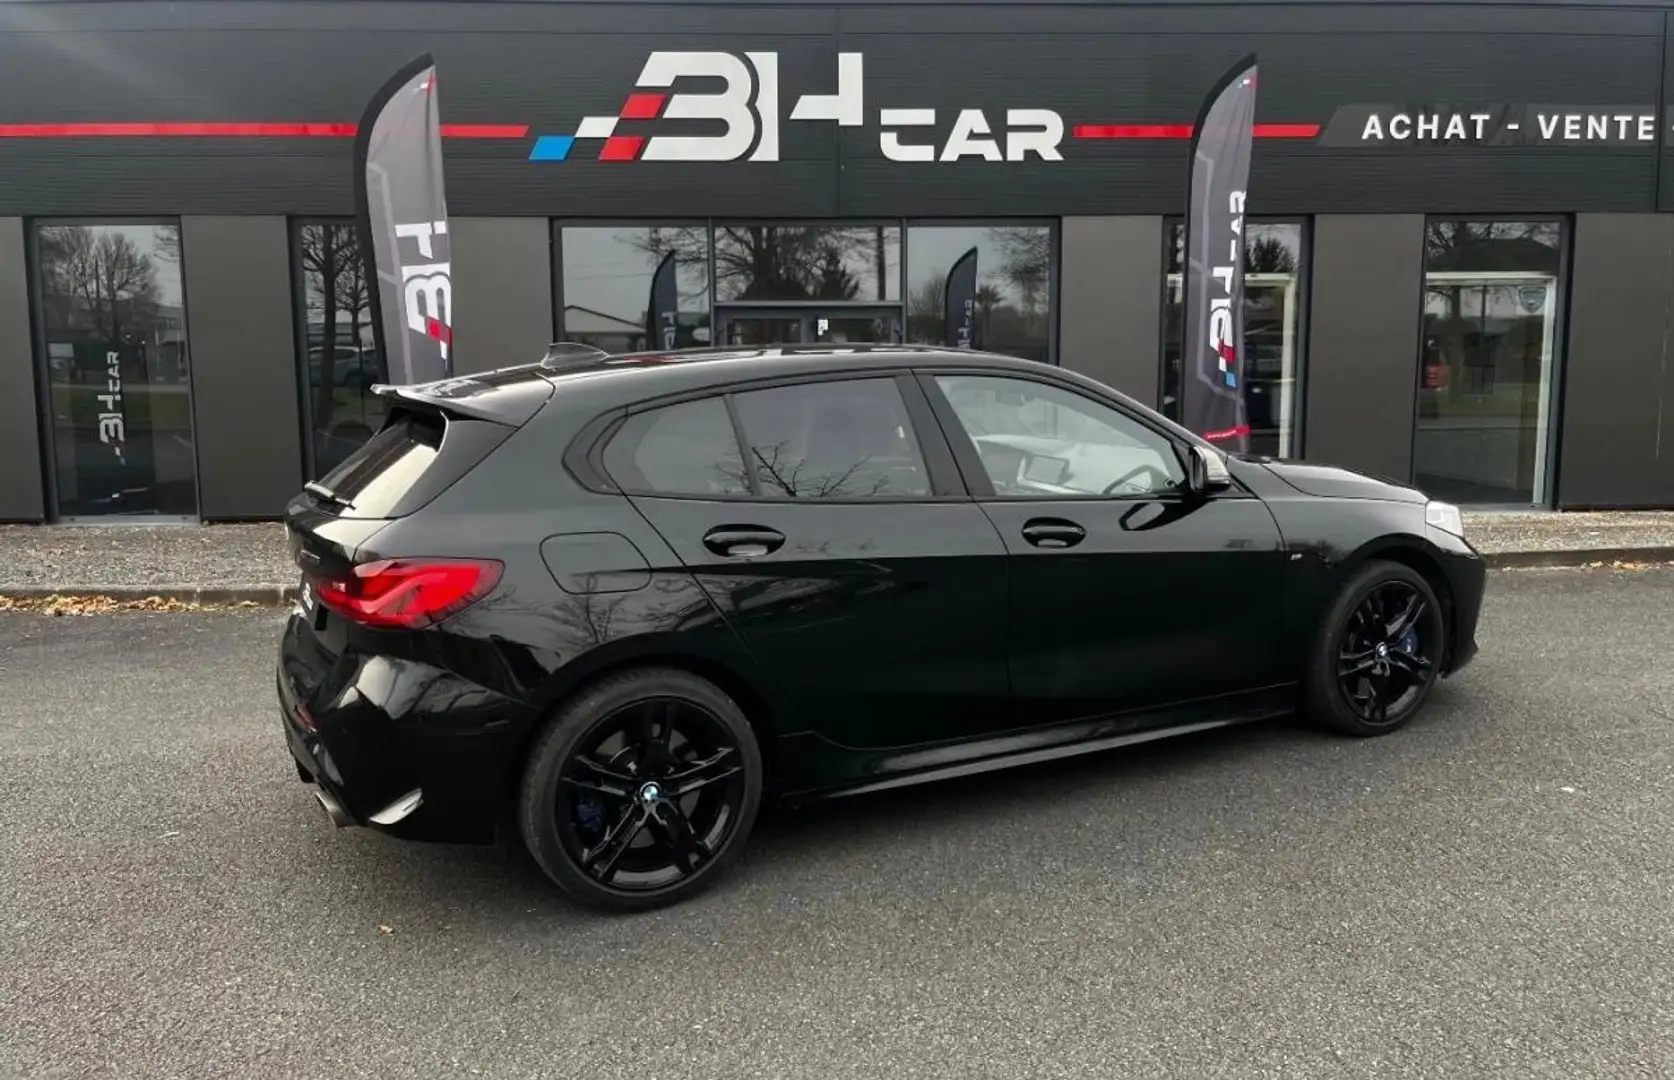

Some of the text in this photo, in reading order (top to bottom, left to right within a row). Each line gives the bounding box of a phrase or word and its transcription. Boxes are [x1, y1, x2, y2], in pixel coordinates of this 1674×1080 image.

[608, 51, 1065, 161] BH CAR
[1361, 114, 1490, 140] ACHAT
[1537, 114, 1656, 140] VENTE
